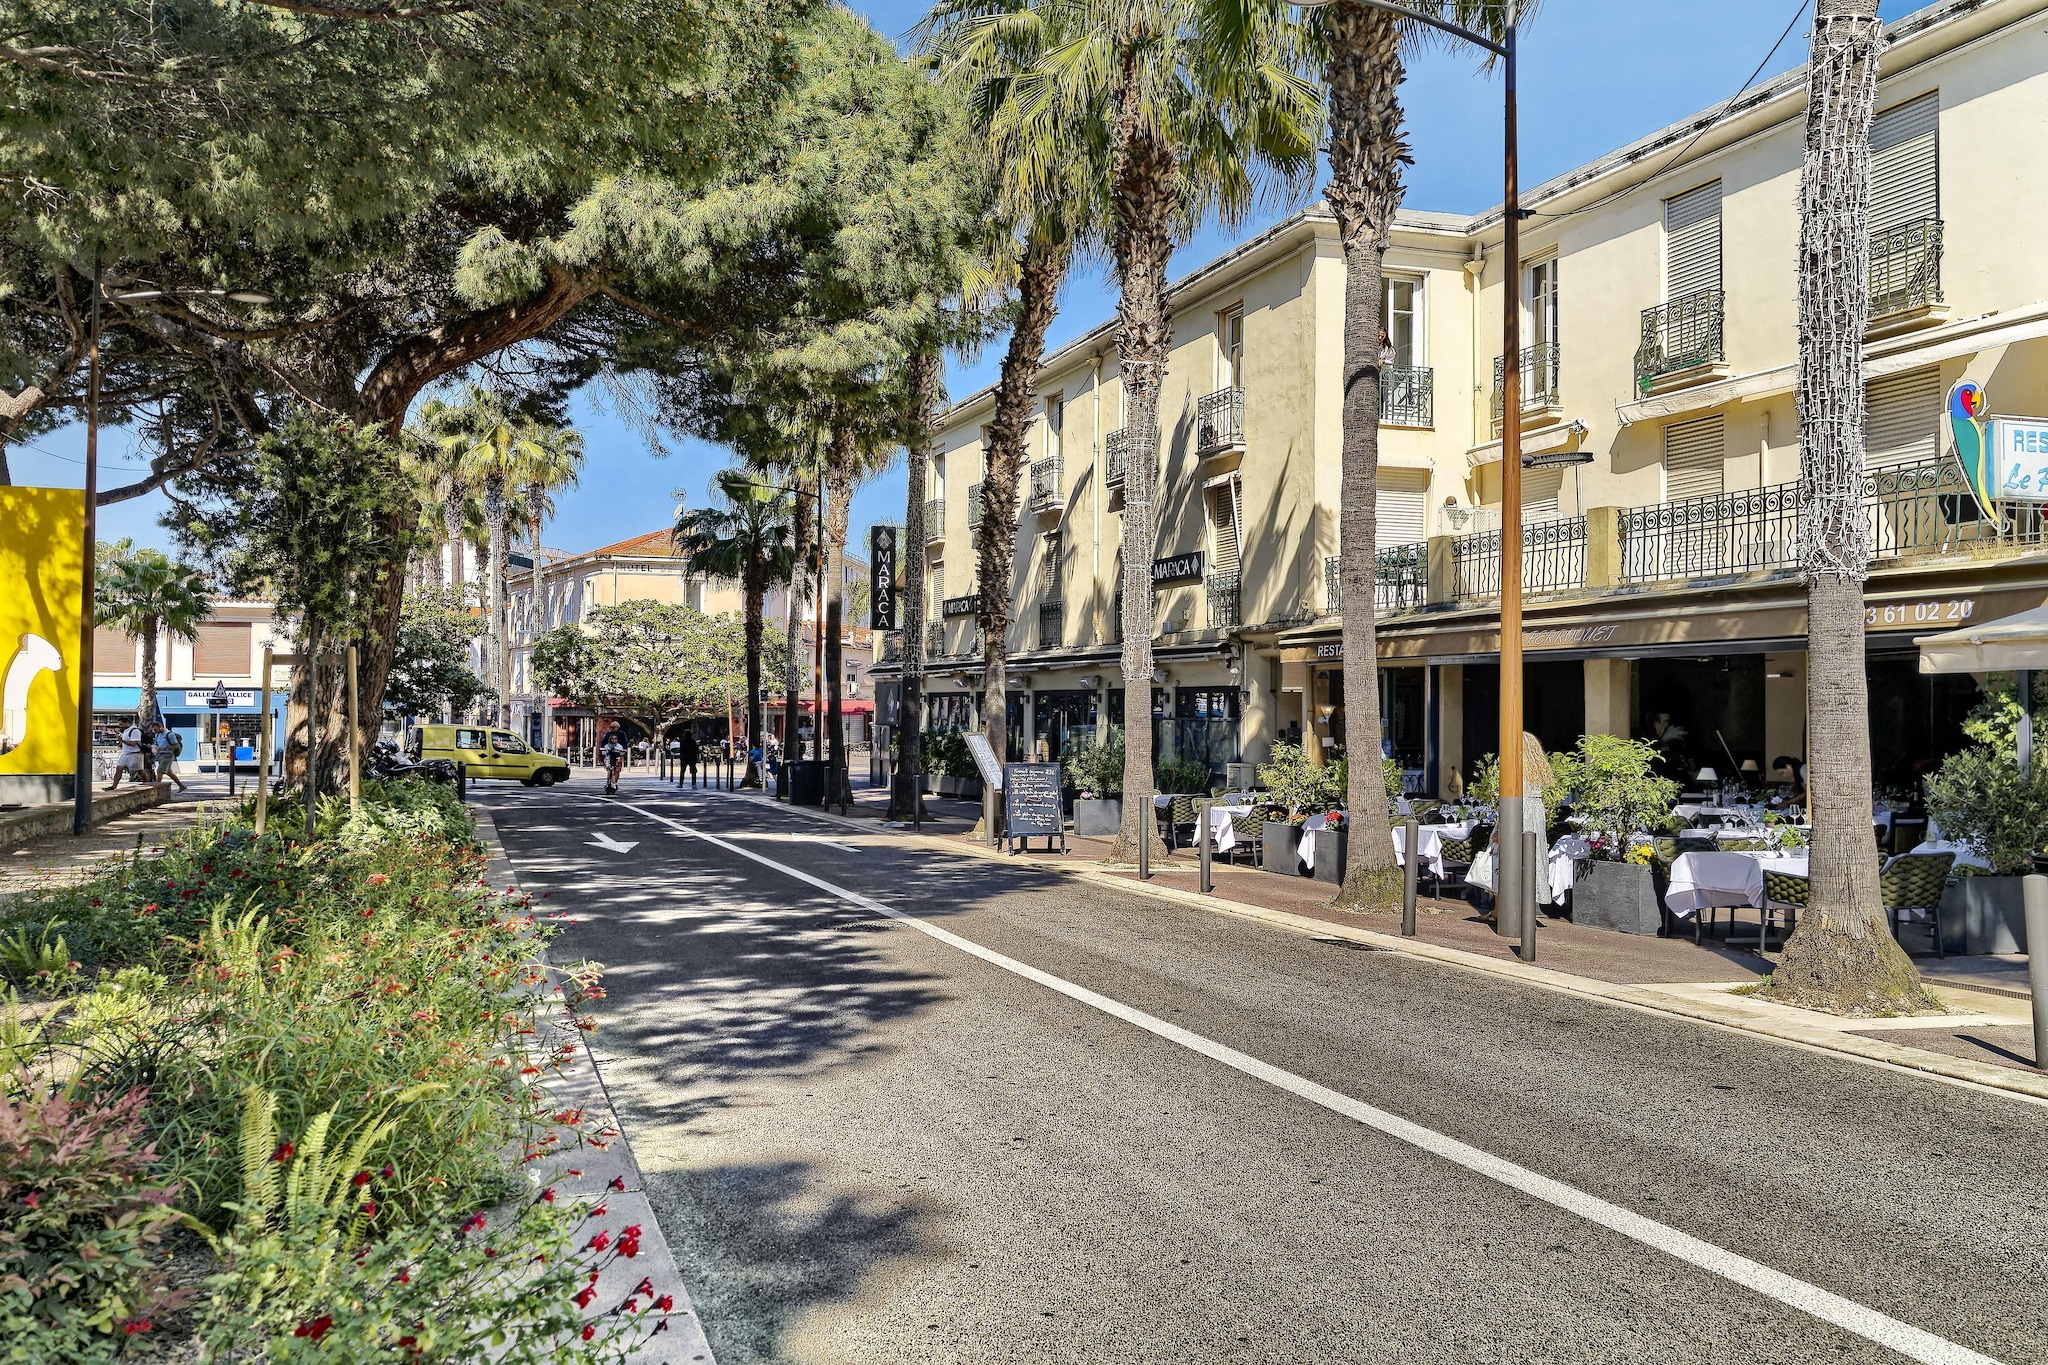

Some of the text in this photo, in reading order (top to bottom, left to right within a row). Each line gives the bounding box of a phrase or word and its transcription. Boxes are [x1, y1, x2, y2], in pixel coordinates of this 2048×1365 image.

[2003, 462, 2031, 490] Le
[1154, 559, 1190, 579] MARACA
[877, 550, 891, 627] MARACA
[1883, 604, 1906, 623] 61
[1914, 602, 1940, 622] 02
[1946, 599, 1974, 620] 20
